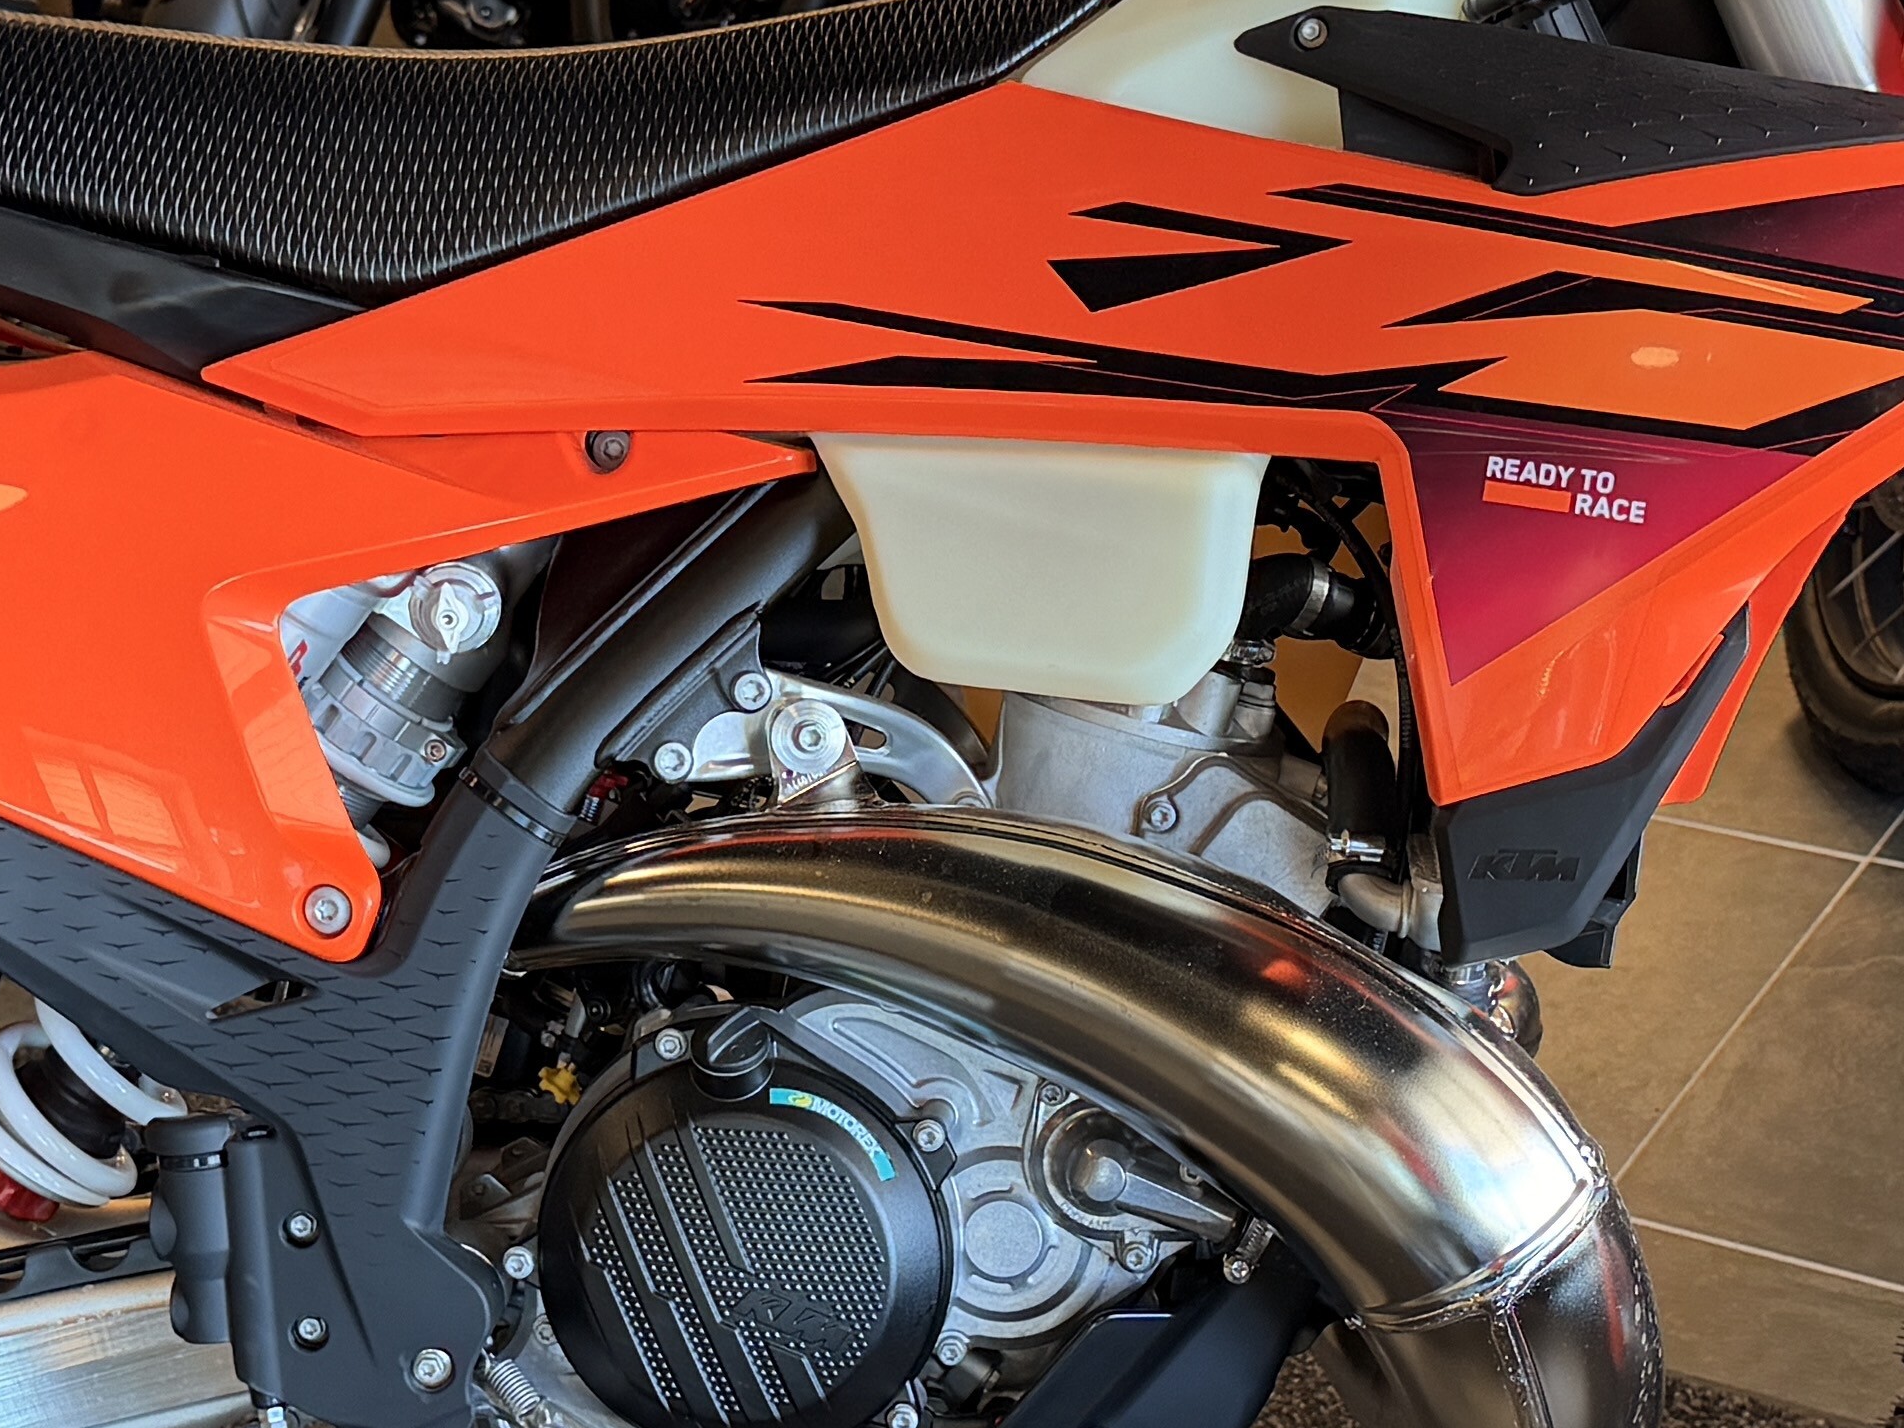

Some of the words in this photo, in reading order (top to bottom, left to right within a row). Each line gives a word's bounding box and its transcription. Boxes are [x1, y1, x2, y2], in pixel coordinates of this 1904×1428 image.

[1486, 456, 1575, 489] READY
[1580, 468, 1615, 495] TO
[1574, 495, 1647, 525] RACE
[1467, 848, 1581, 882] KTM
[811, 1099, 882, 1160] MOTOREX
[732, 1288, 854, 1362] KTM
